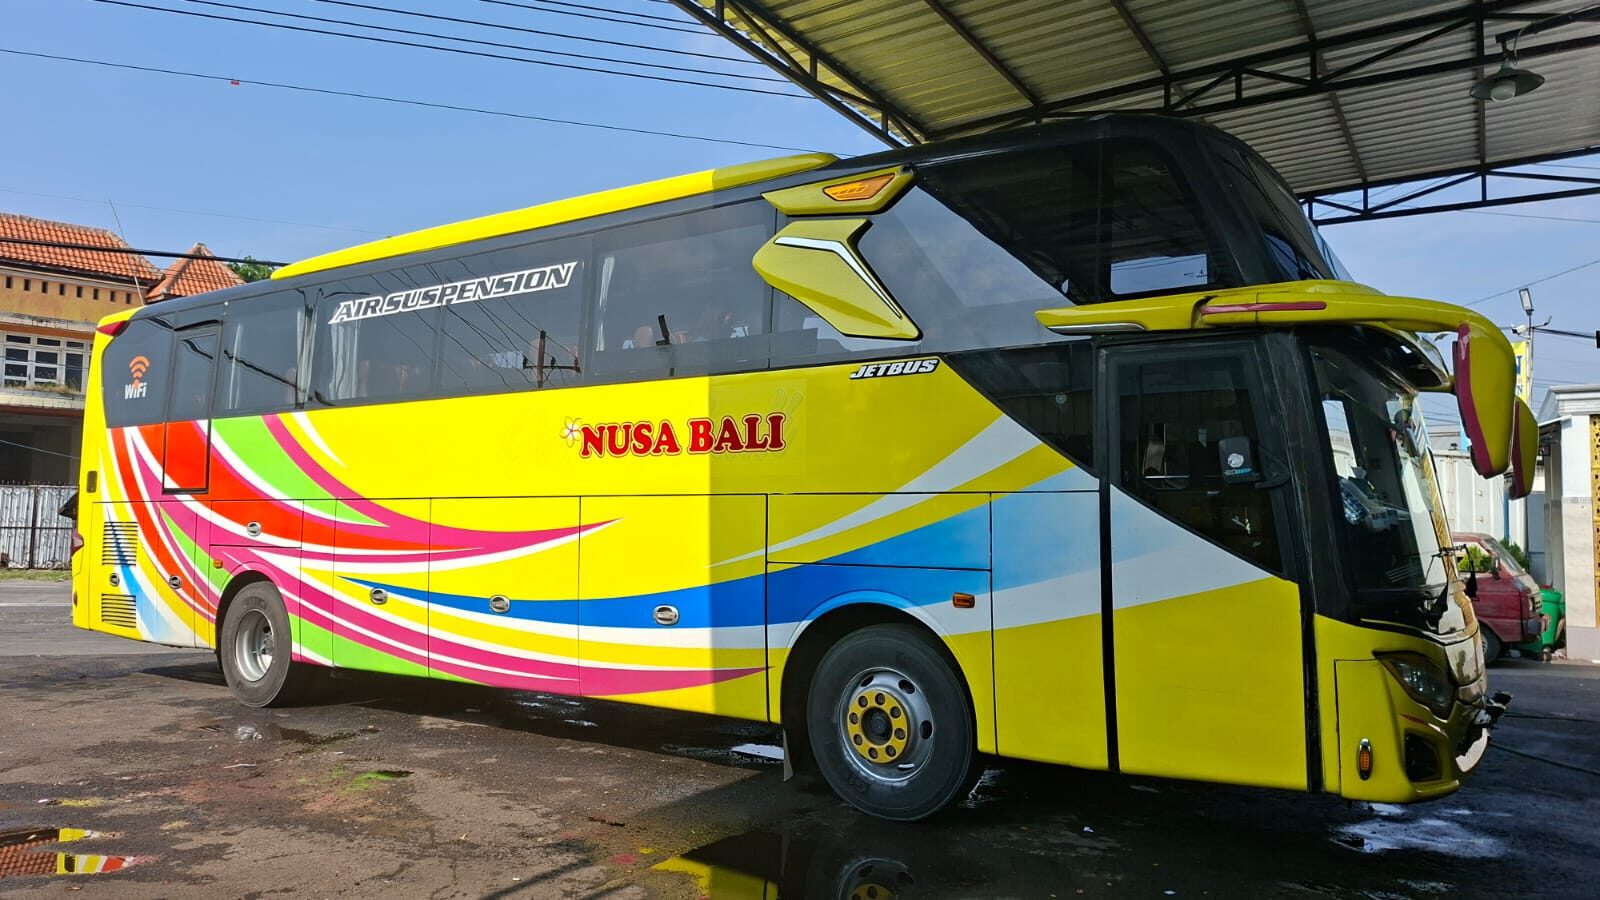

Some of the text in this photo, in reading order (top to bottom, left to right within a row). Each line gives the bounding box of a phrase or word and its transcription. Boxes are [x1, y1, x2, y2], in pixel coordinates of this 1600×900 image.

[850, 359, 938, 379] JETBUS
[579, 412, 786, 458] NUSA BALI
